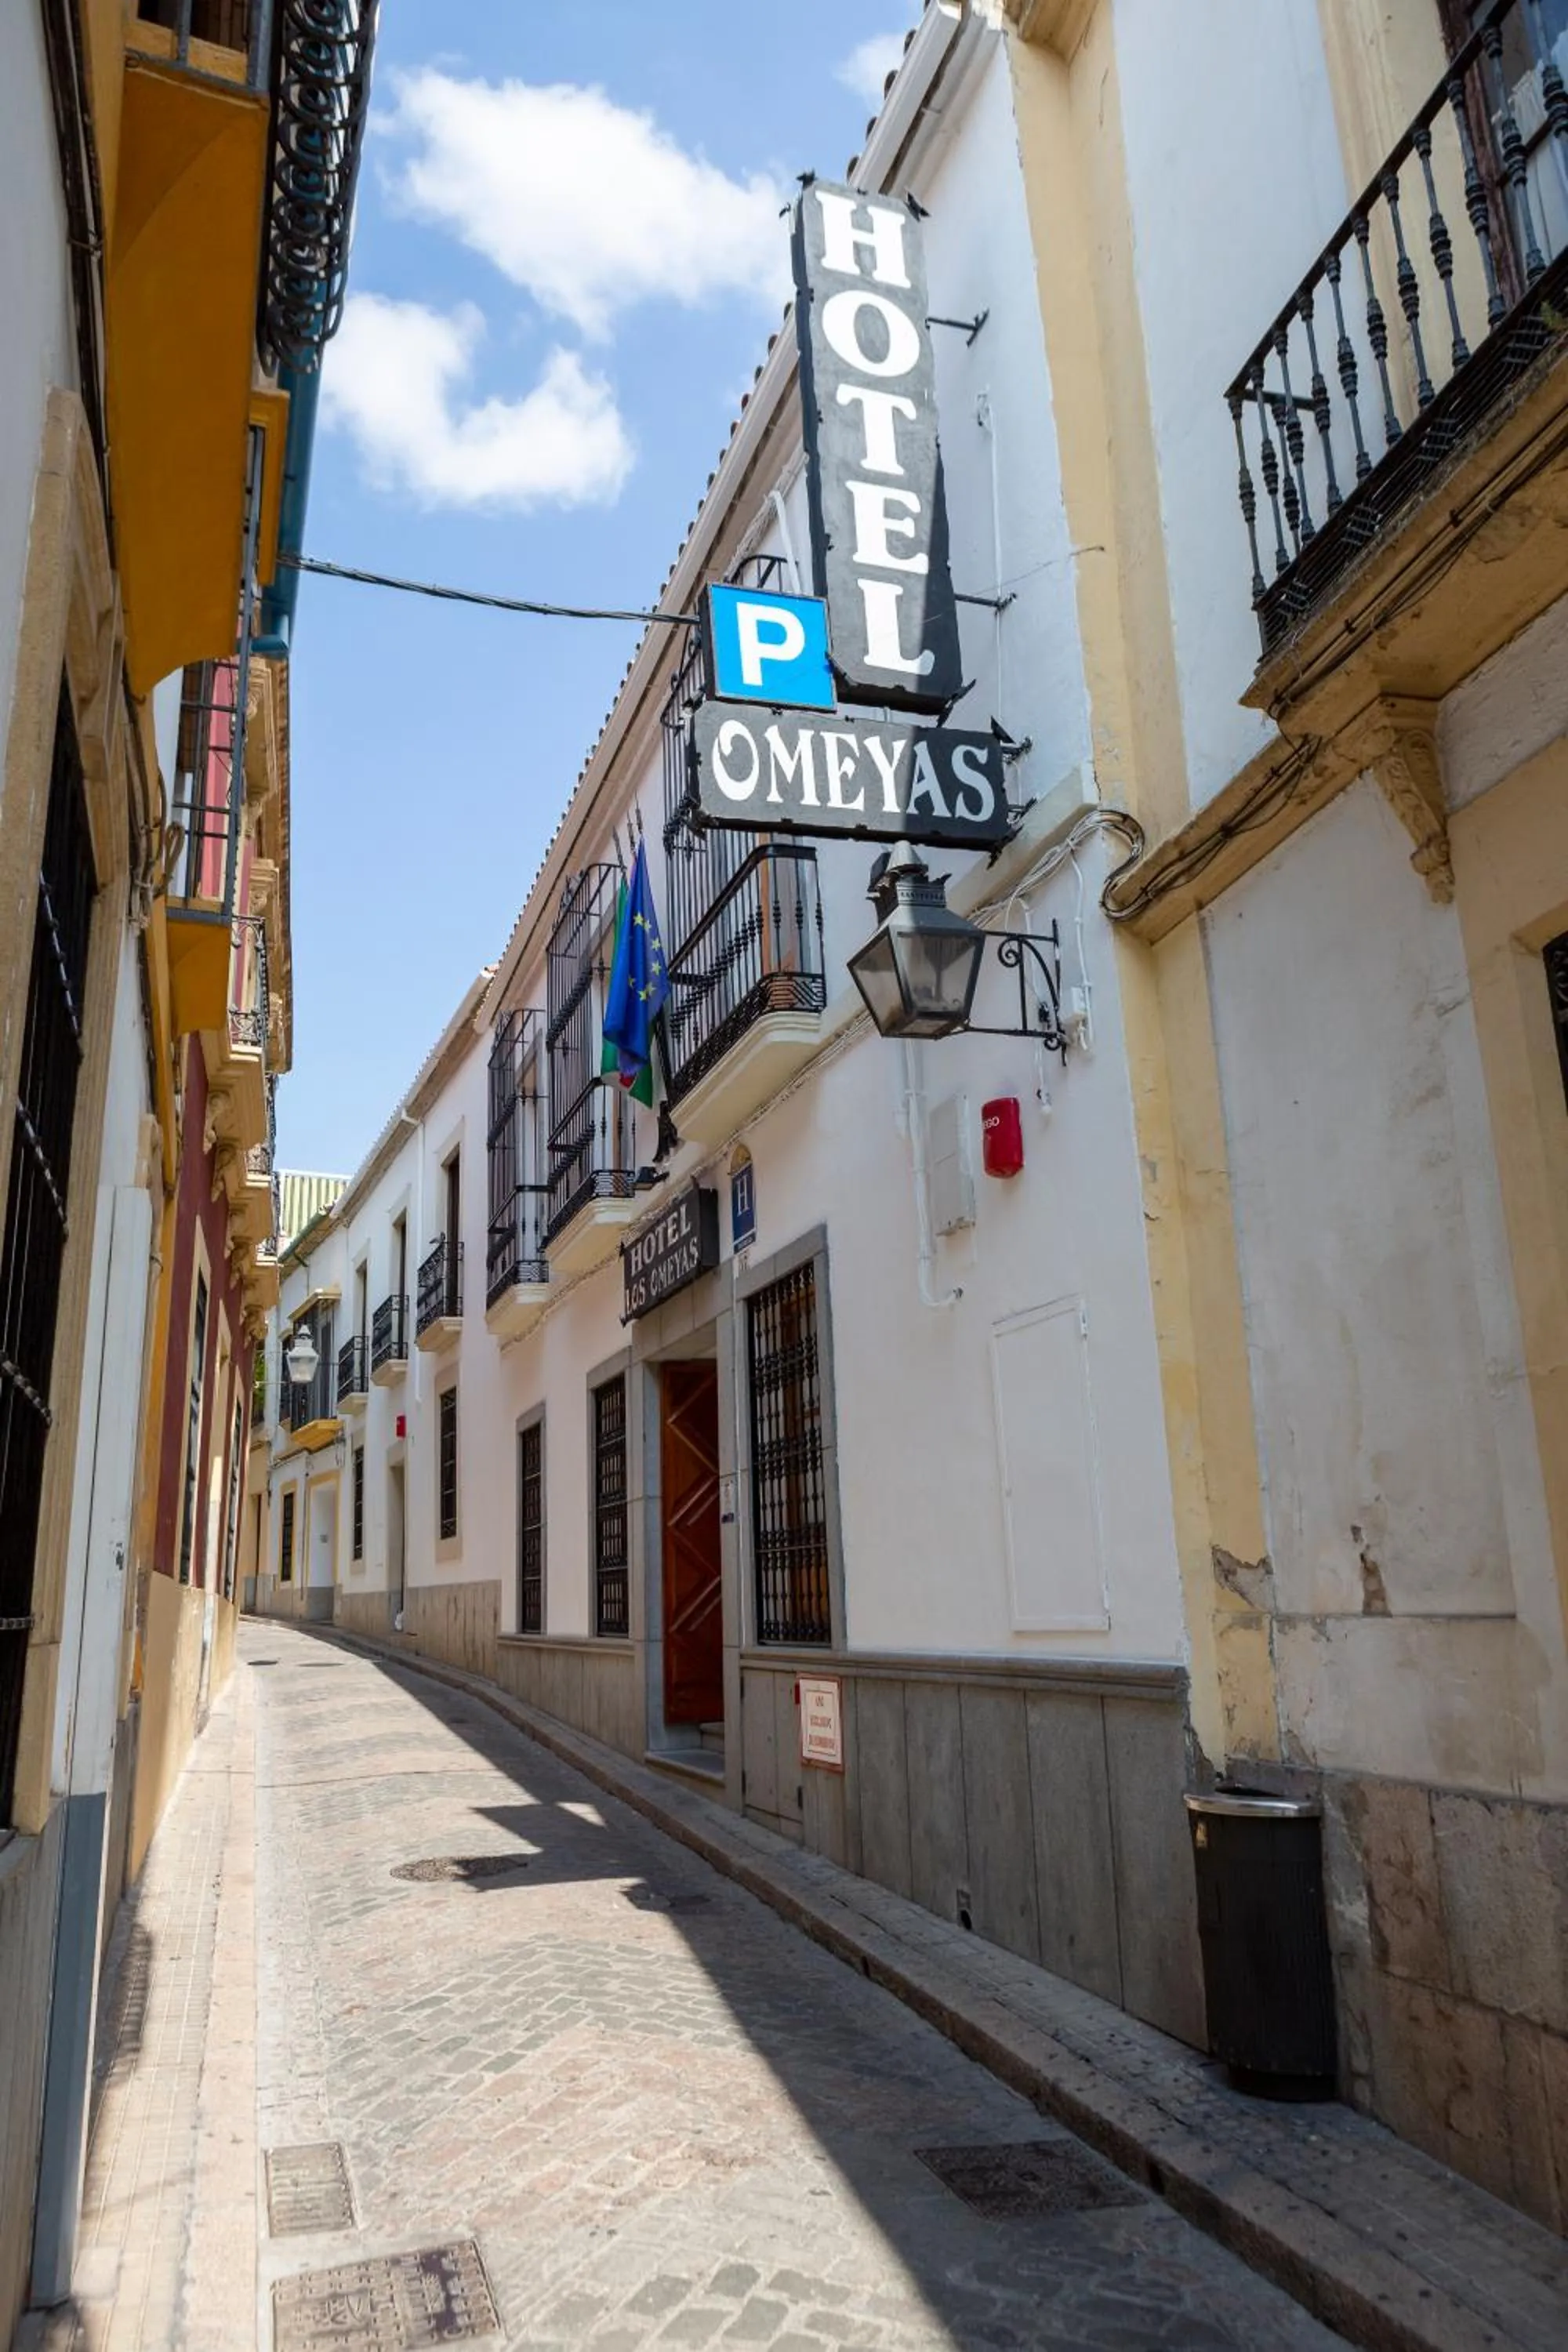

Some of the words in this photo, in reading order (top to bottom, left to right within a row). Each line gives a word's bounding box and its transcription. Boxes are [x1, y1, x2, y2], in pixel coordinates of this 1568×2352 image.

[815, 190, 935, 677] HOTEL
[736, 602, 806, 687] P
[711, 718, 996, 824] OMEYAS
[736, 1174, 750, 1217] H
[630, 1203, 691, 1277] HOTEL
[650, 1236, 699, 1297] OMEYAS
